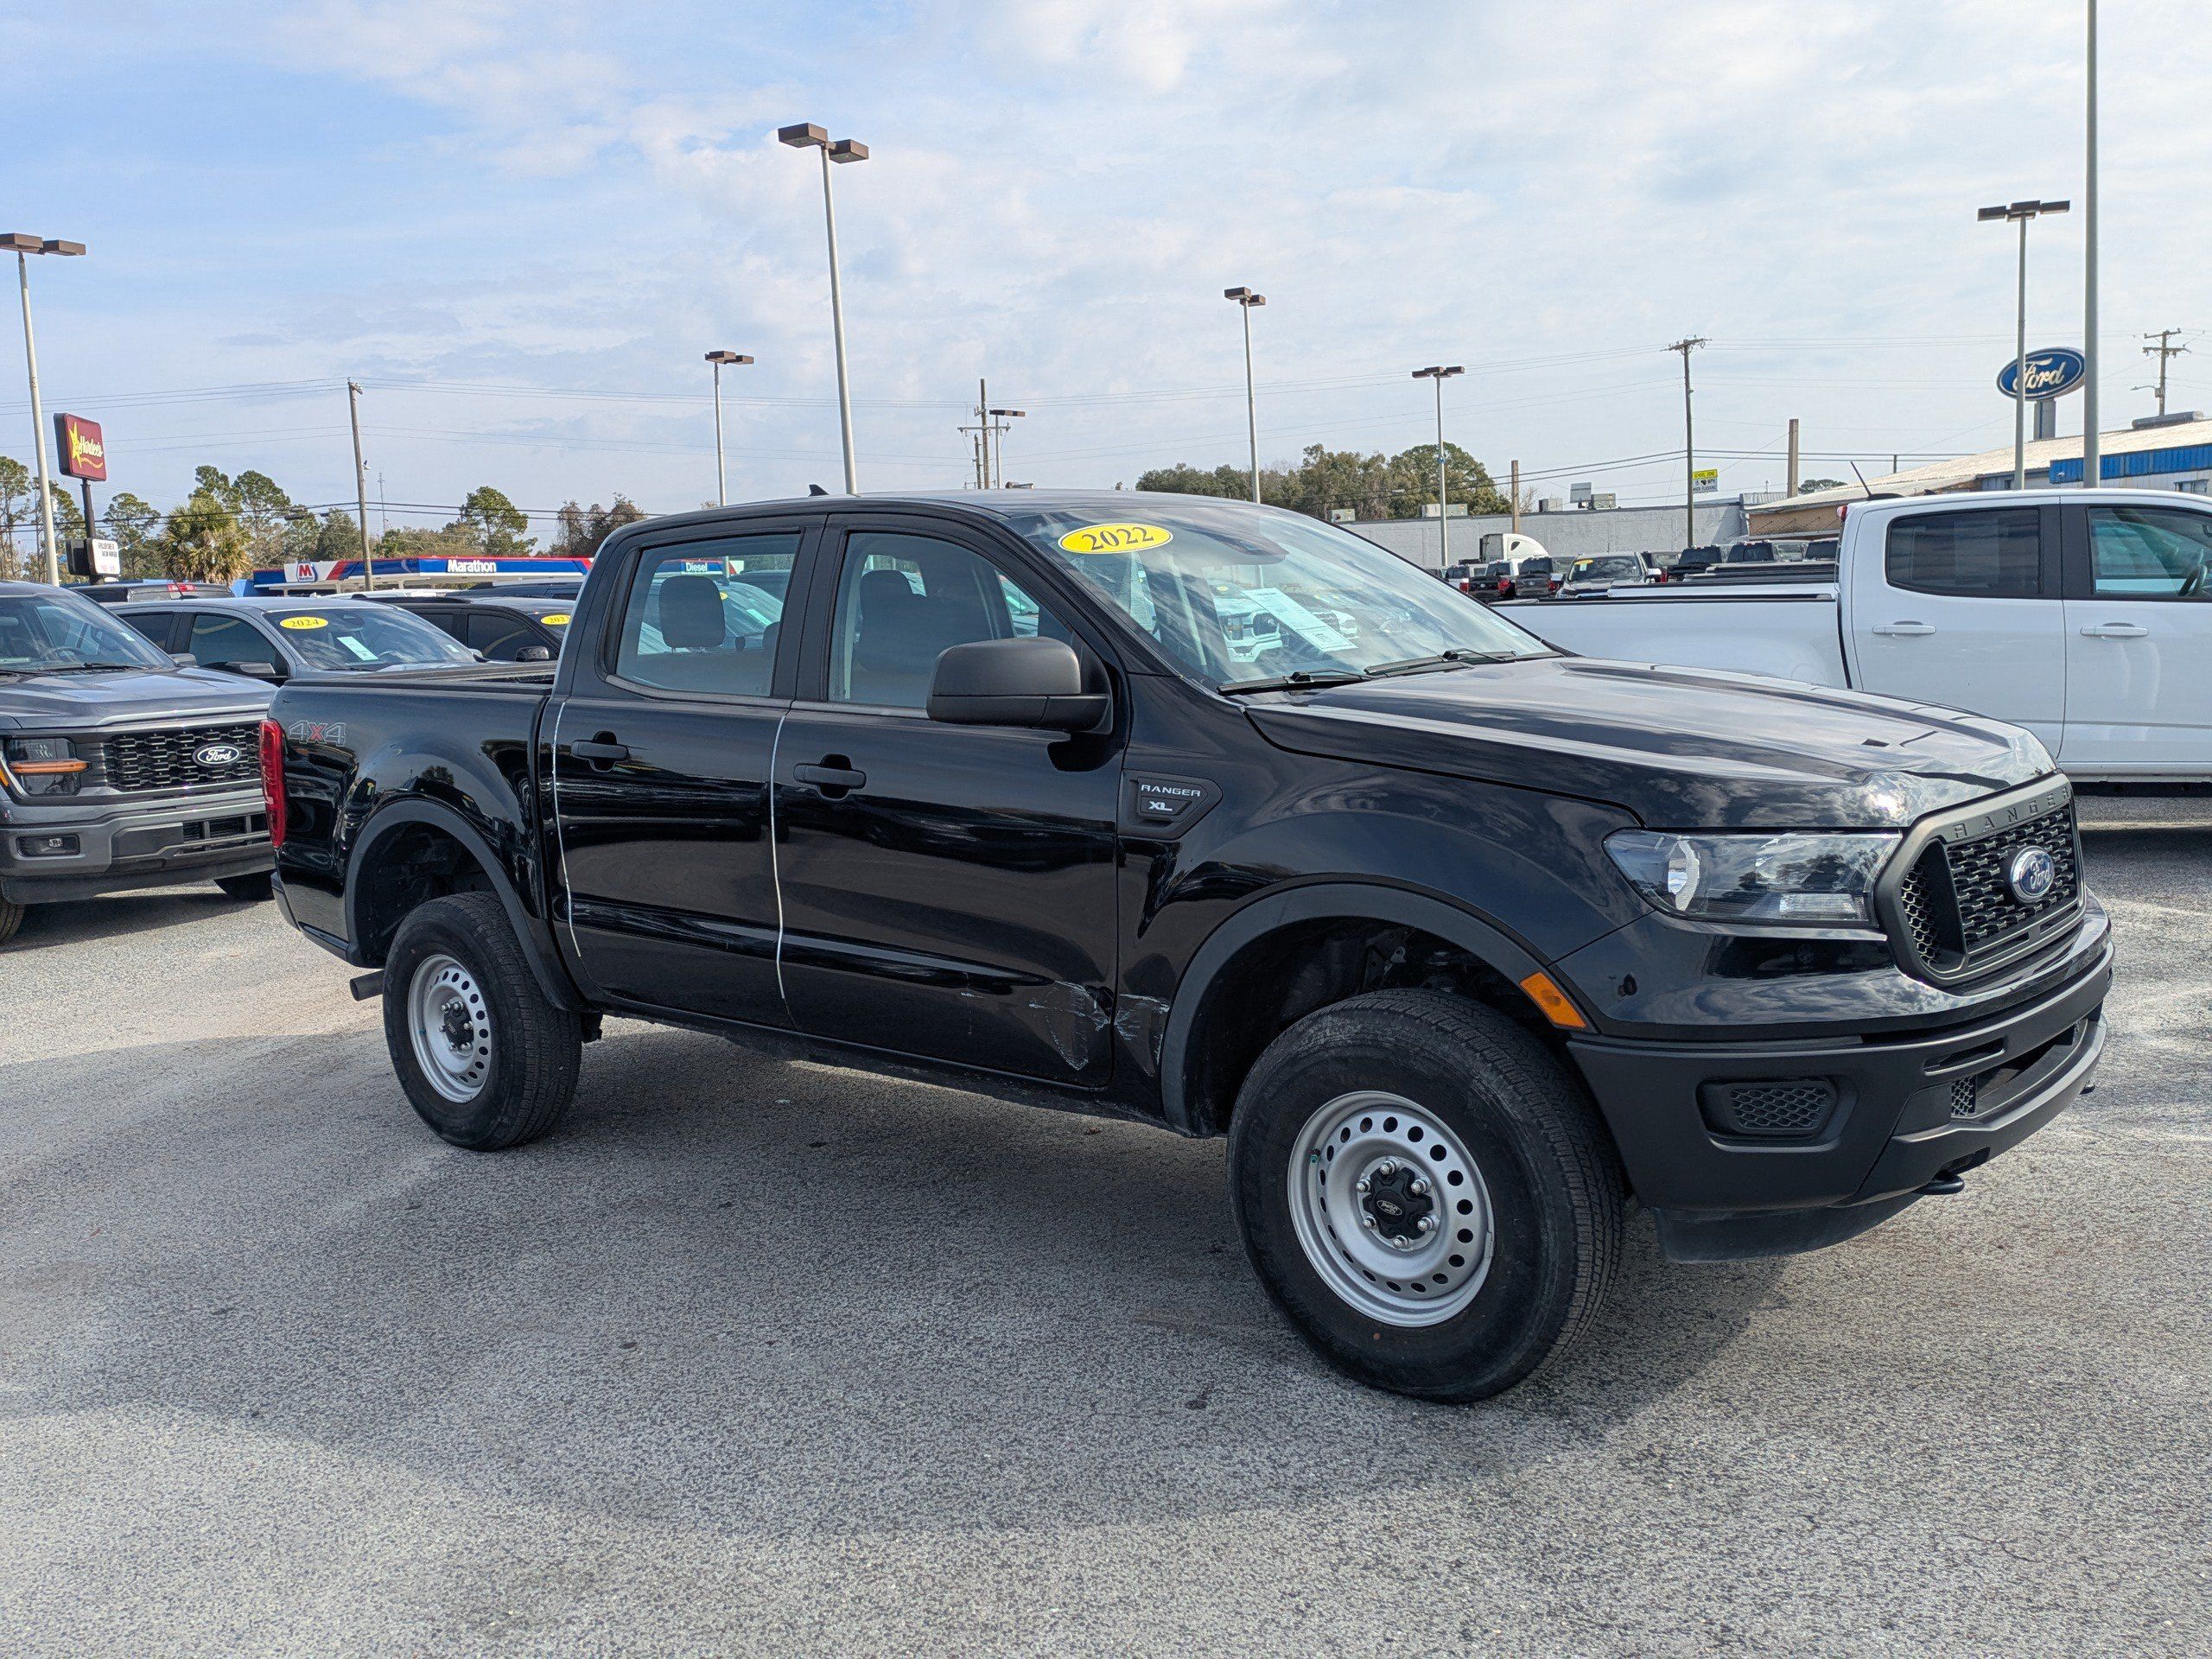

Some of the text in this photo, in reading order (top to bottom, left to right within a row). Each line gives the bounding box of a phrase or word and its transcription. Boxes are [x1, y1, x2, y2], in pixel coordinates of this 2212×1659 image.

[2012, 358, 2066, 390] Ford
[1081, 526, 1154, 550] 2022
[298, 564, 313, 576] M
[448, 559, 497, 573] Marathon
[685, 562, 708, 572] Diesel
[289, 619, 320, 628] 2024
[206, 748, 232, 762] Ford
[1141, 784, 1201, 798] RANGER
[1147, 800, 1173, 811] XL
[1952, 785, 2070, 839] RANGER
[2030, 851, 2051, 890] Ford
